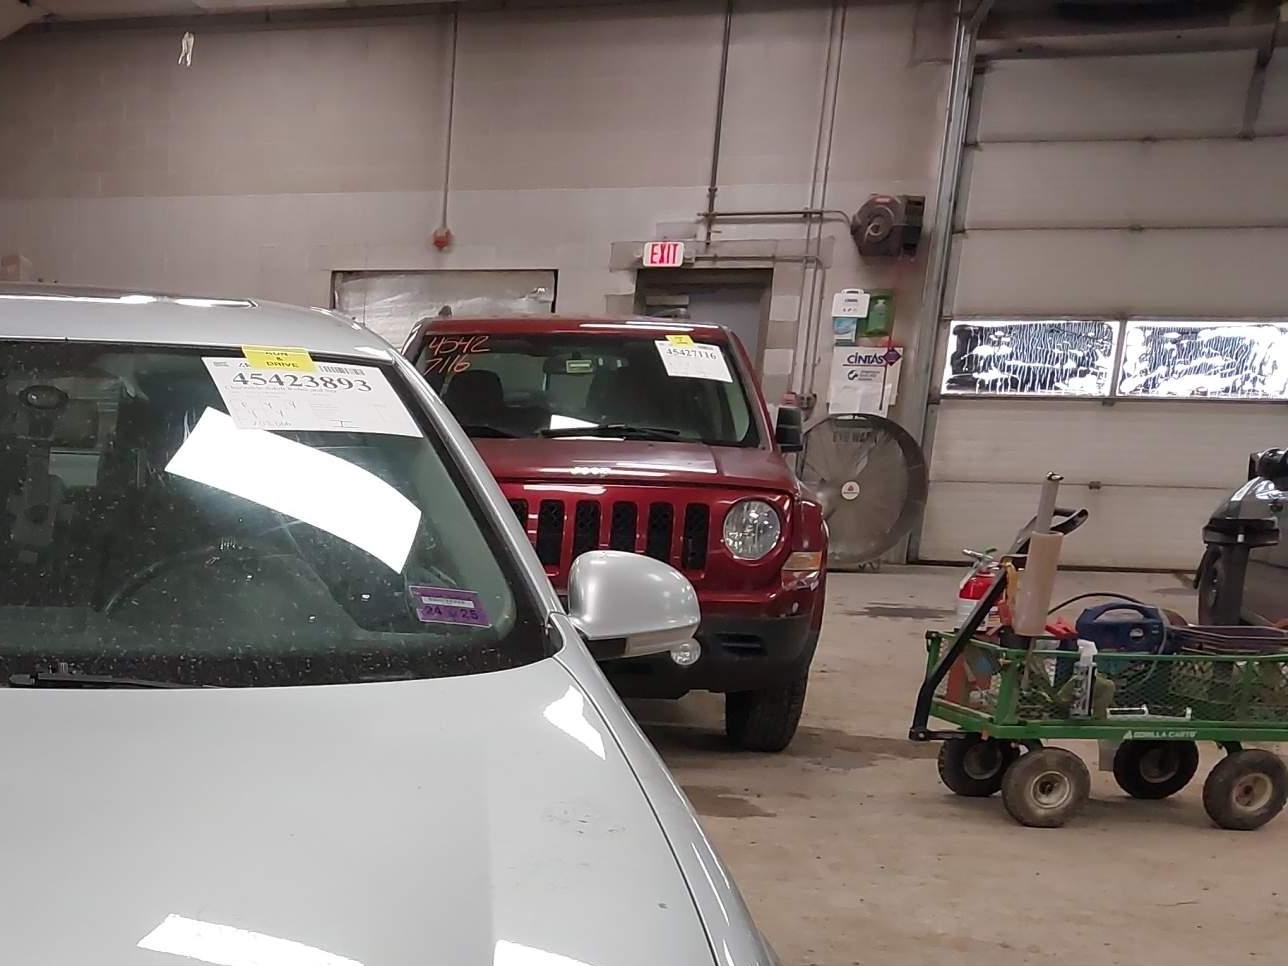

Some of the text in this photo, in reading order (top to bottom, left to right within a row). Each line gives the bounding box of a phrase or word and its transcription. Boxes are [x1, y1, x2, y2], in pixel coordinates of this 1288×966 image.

[650, 243, 678, 264] EXIT
[428, 335, 491, 356] 4542
[423, 354, 471, 376] 7116
[232, 372, 373, 393] 45423893
